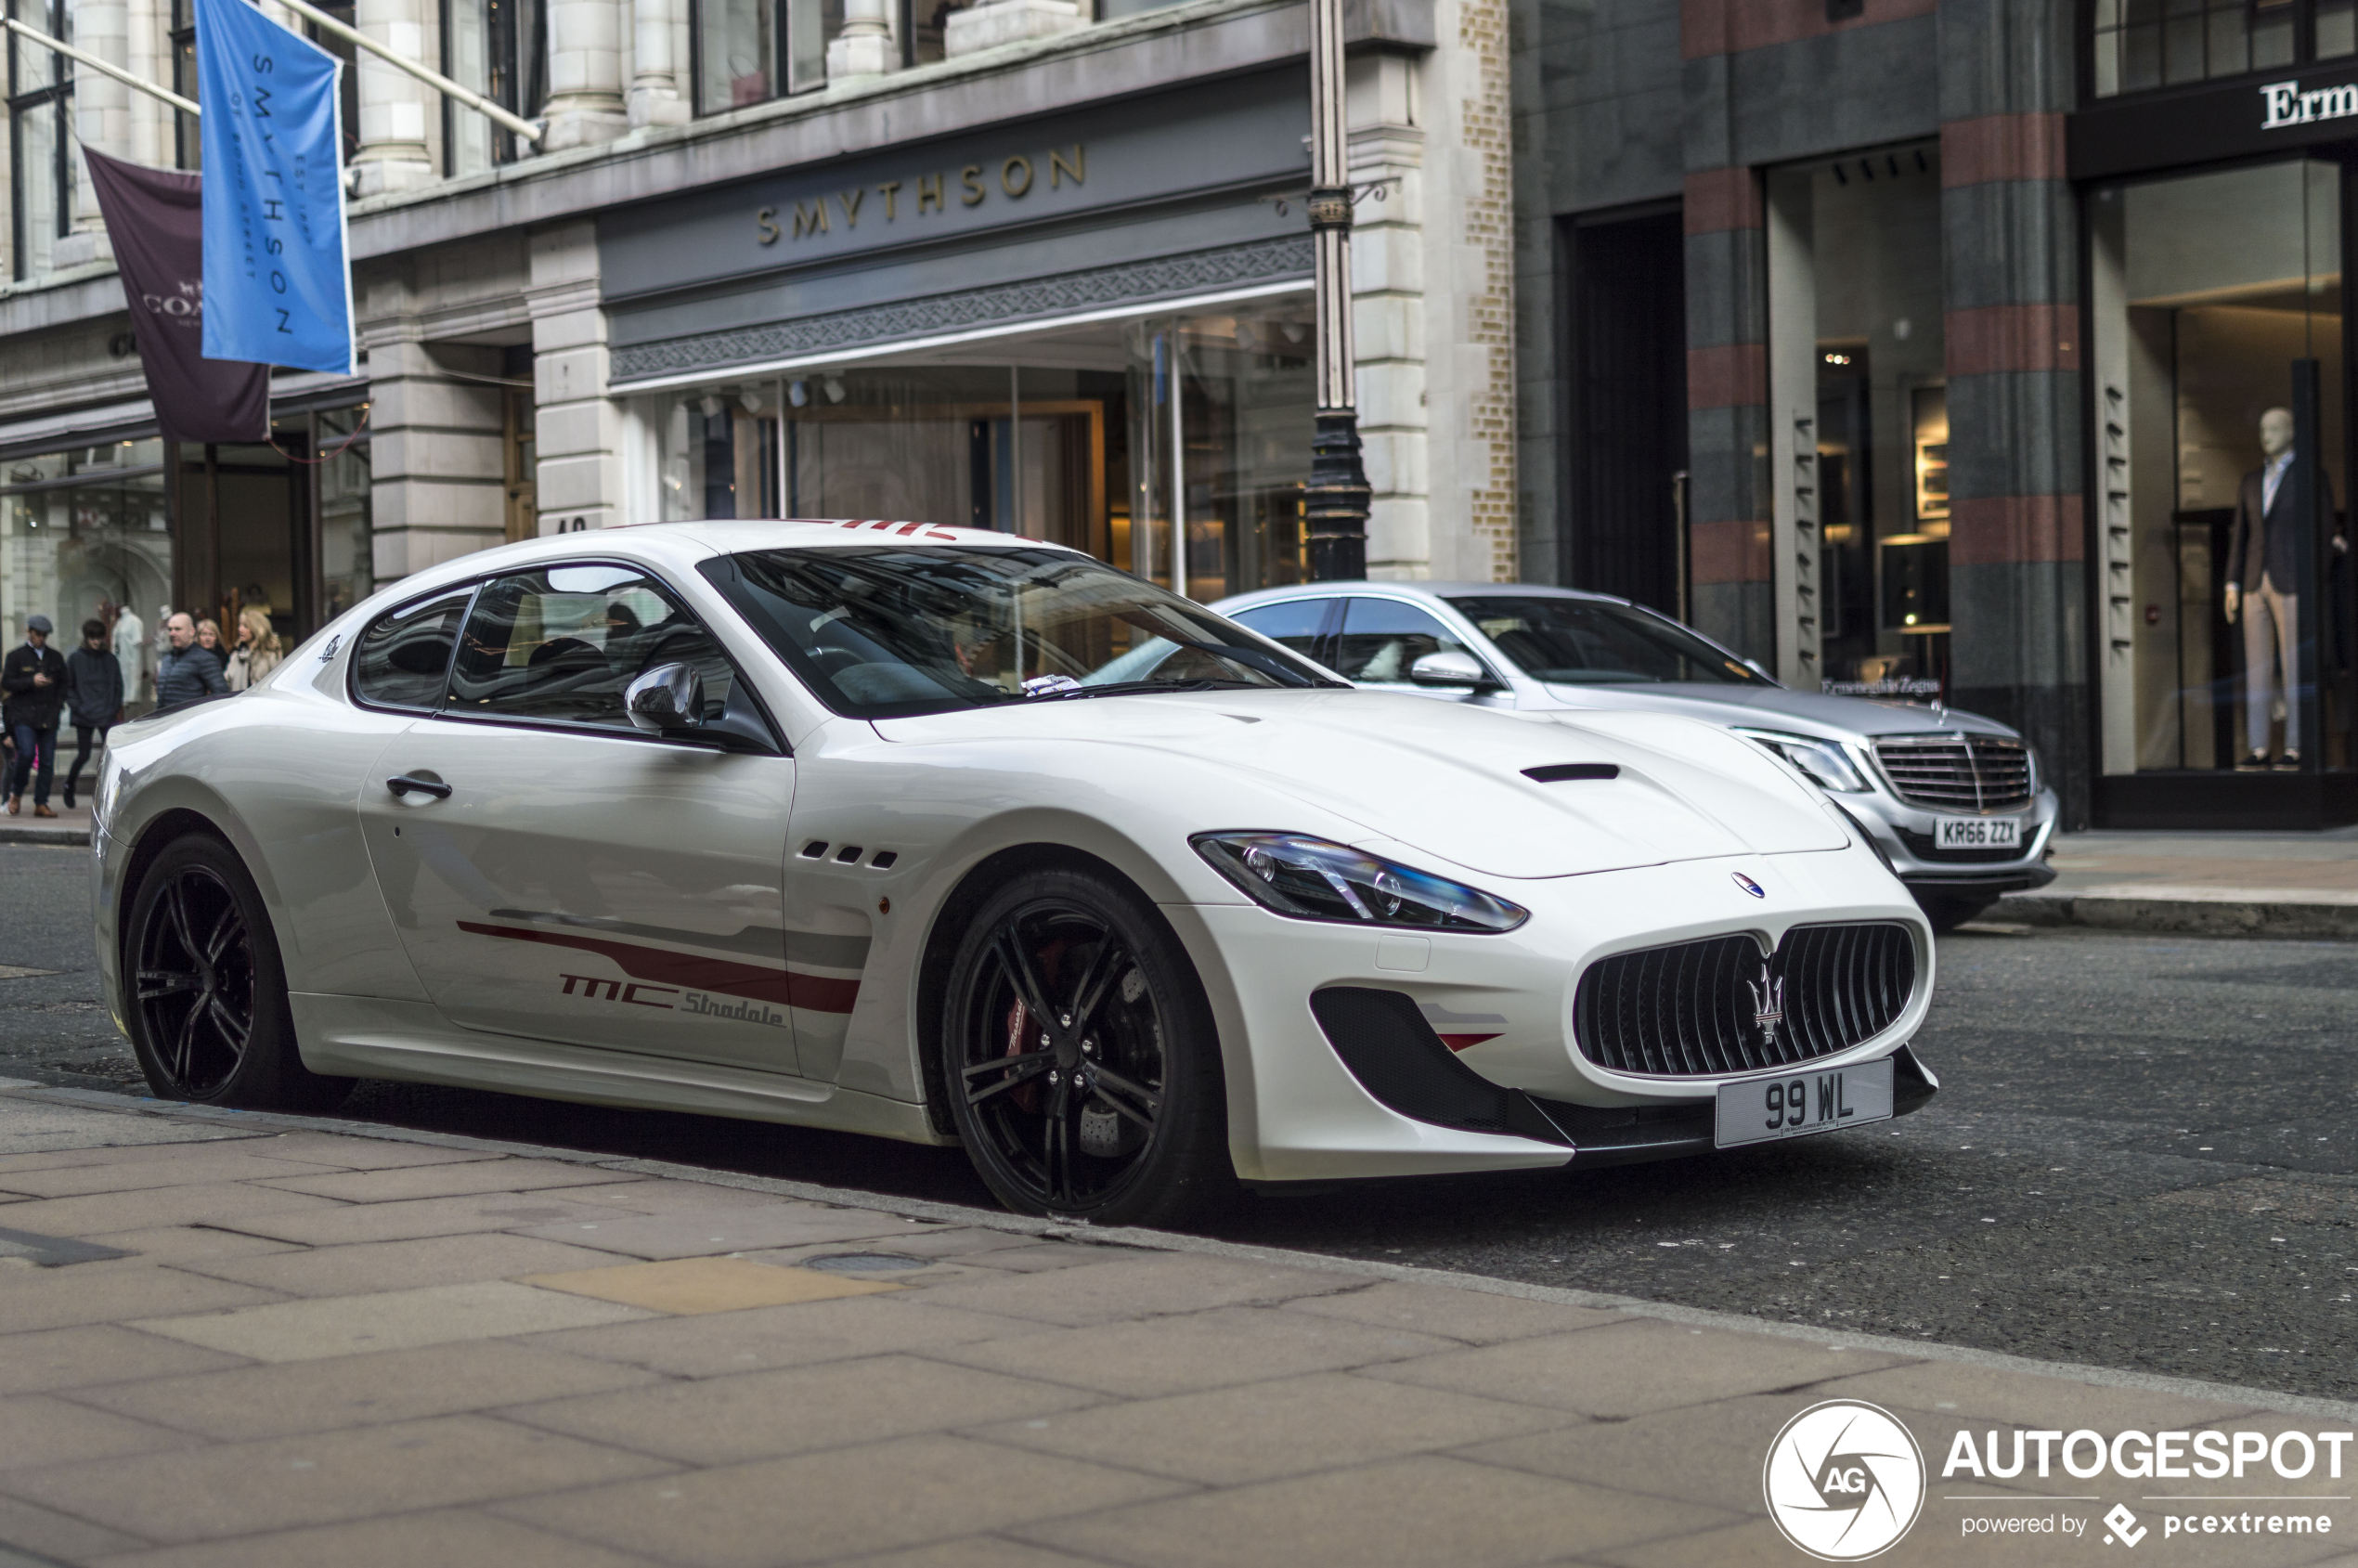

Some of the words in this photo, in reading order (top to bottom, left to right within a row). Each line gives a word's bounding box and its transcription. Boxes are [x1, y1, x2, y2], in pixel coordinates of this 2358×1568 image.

[2259, 80, 2358, 130] Erm
[253, 53, 292, 335] SMYTHSON
[757, 144, 1083, 244] SMYTHSON
[1899, 675, 1940, 696] Zegna
[1943, 822, 1986, 844] KR66
[1989, 822, 2015, 844] ZZX
[680, 991, 787, 1030] Stradale
[1766, 1080, 1806, 1130] 99
[1817, 1072, 1854, 1121] WL
